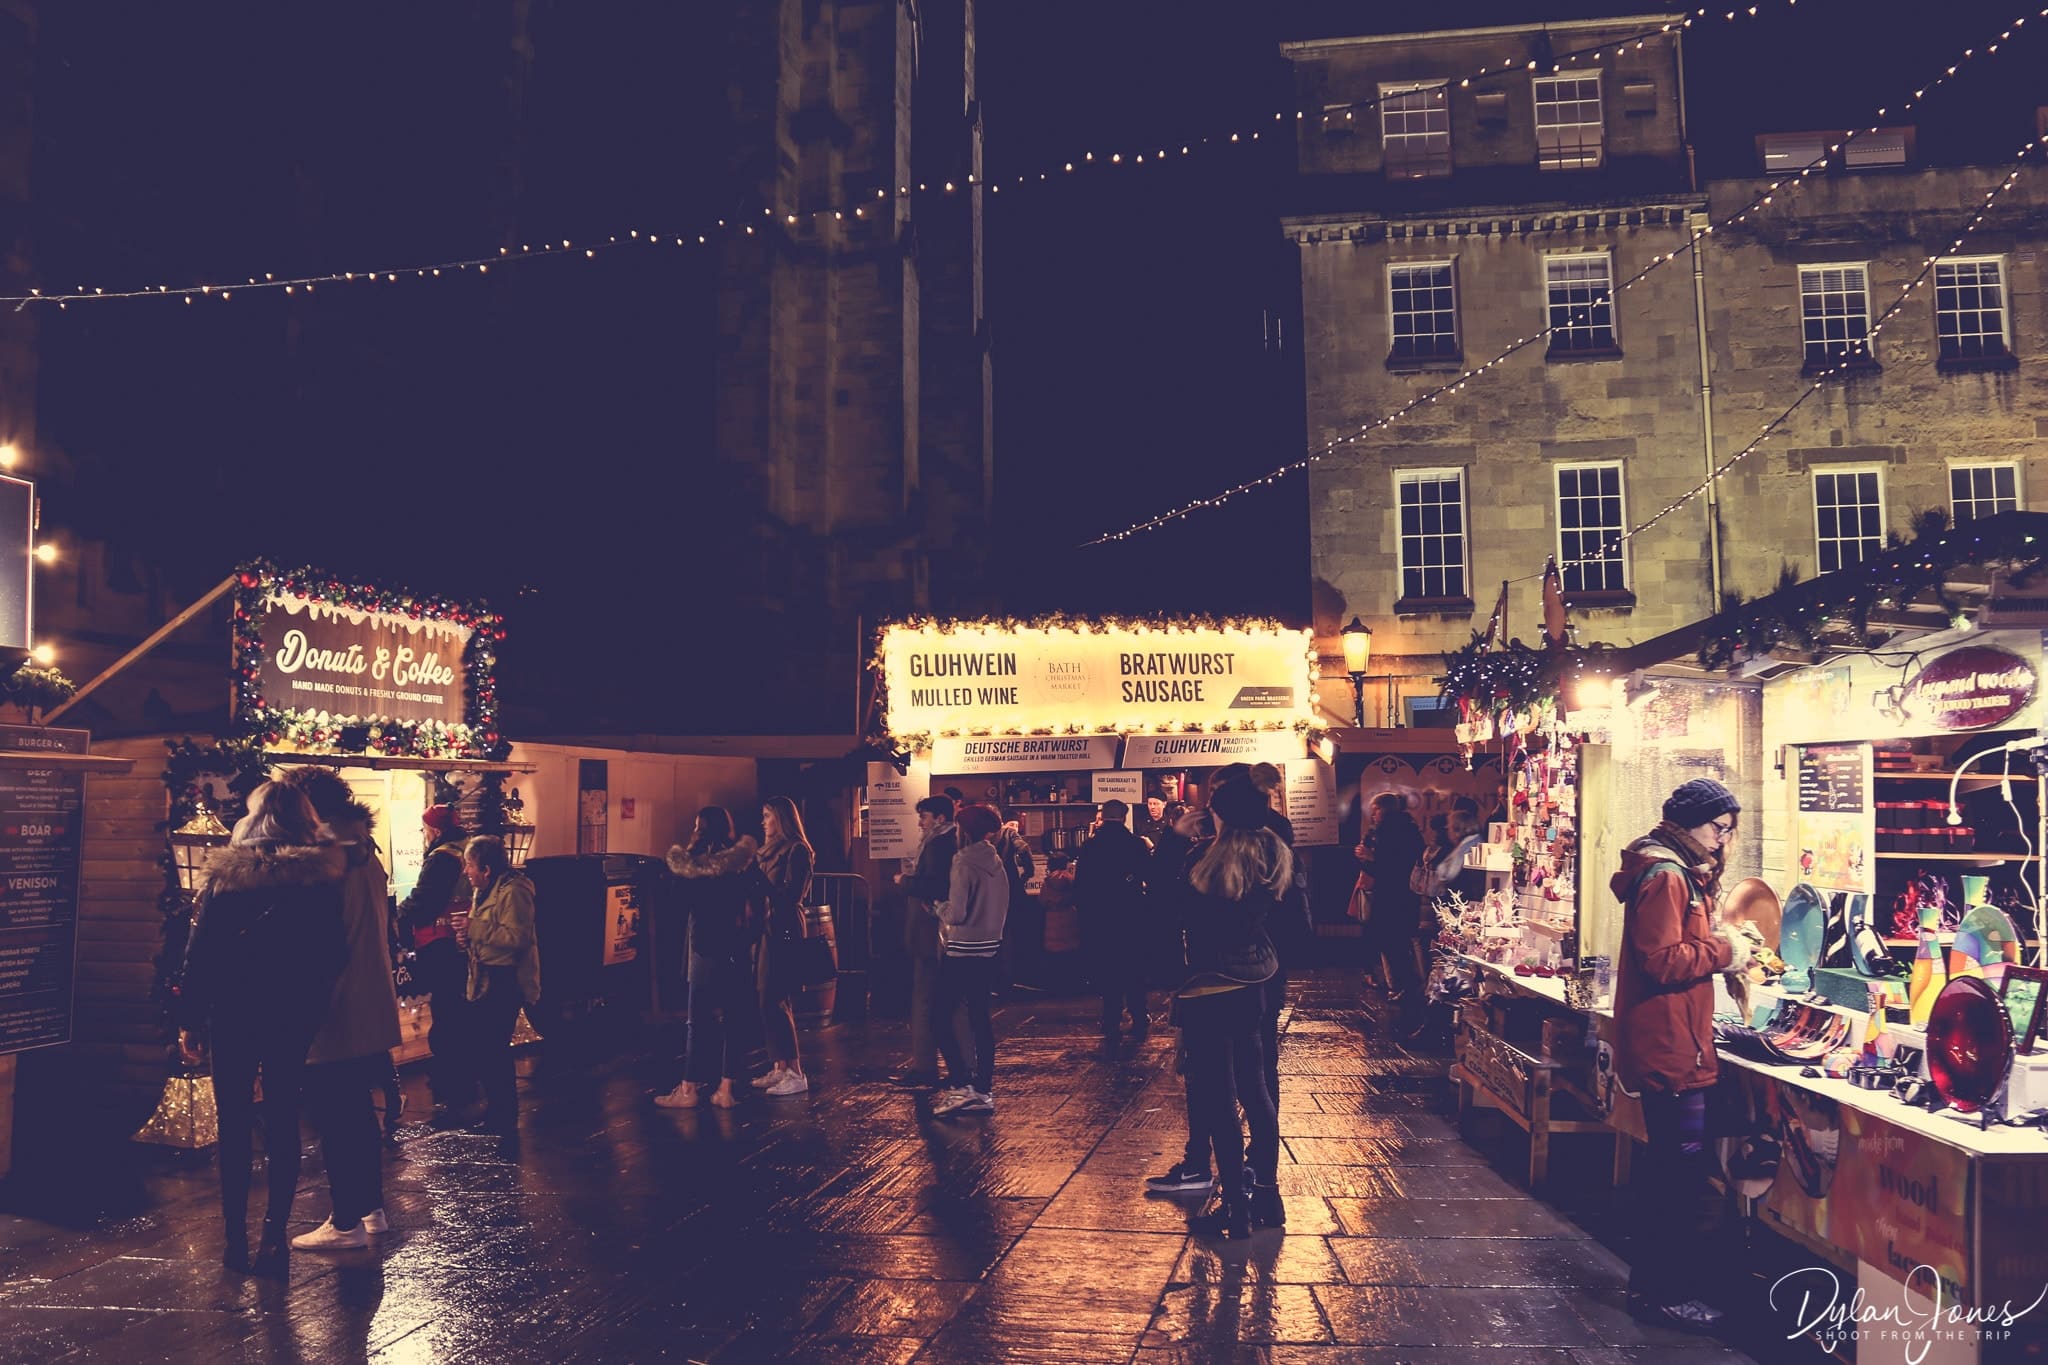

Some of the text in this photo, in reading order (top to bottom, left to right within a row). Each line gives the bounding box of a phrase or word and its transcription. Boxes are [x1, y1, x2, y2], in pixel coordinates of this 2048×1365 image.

[276, 629, 454, 686] Donuts & Coffee
[910, 652, 1016, 677] GLUHWEIN
[1120, 653, 1234, 676] BRATWURST
[1048, 662, 1081, 674] BATH
[292, 680, 444, 704] HAND MADE DONUTS & FRESHLY GROUND COFFEE
[912, 687, 1019, 707] MULLED WINE
[1122, 680, 1204, 703] SAUSAGE
[18, 738, 52, 748] BURGER
[964, 739, 1089, 755] DEUTSCHE BRATWURST
[1154, 739, 1221, 755] GLUHWEIN
[1007, 754, 1029, 762] SAUSAGE
[20, 824, 52, 836] BOAR
[8, 876, 57, 890] VENISON
